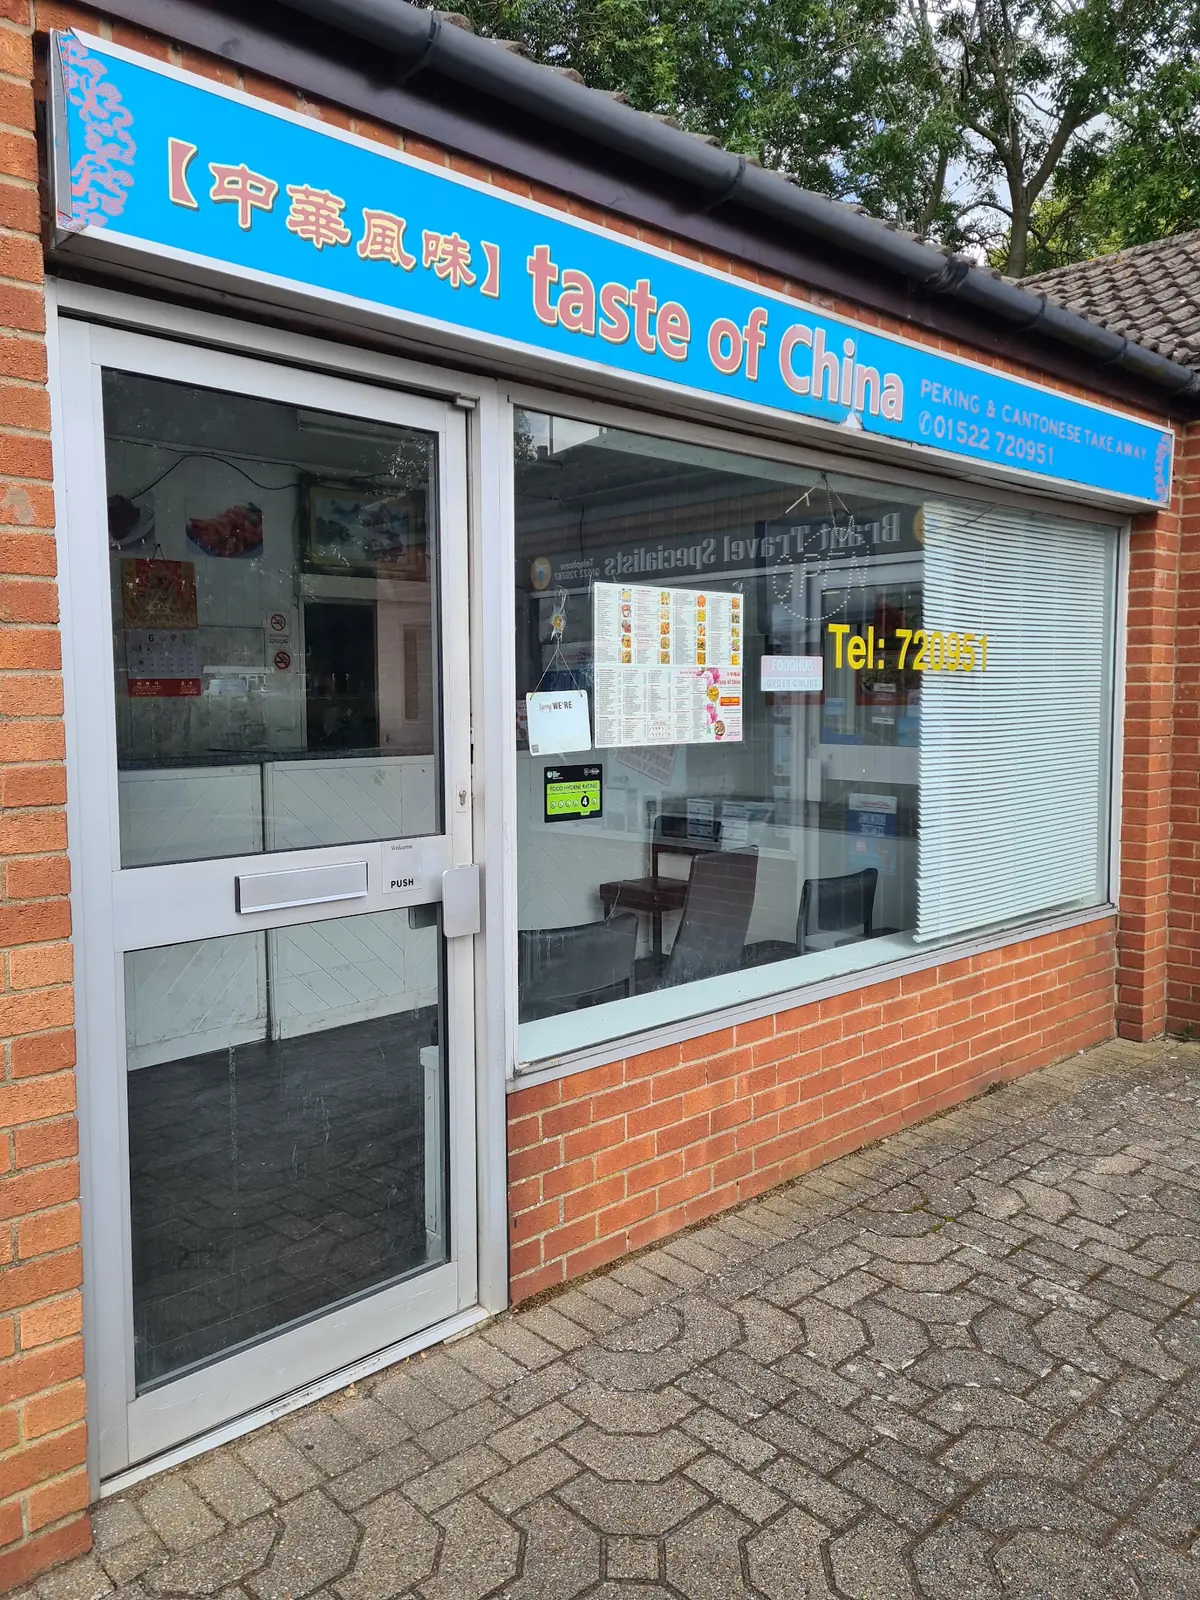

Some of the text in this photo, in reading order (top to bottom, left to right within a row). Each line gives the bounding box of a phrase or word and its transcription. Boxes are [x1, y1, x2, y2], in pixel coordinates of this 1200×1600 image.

[526, 244, 904, 423] taste of China
[920, 379, 1147, 460] PEKING & CANTONESE TAKE AWAY
[933, 415, 1053, 466] 01522 720951
[828, 624, 885, 670] Tel:
[895, 629, 988, 672] 720951
[772, 658, 813, 671] FOODHUB
[766, 678, 818, 688] ORDER ONLINE
[552, 701, 573, 710] WE'RE
[582, 796, 588, 806] 4
[391, 843, 413, 851] Welcome
[390, 877, 414, 889] PUSH
